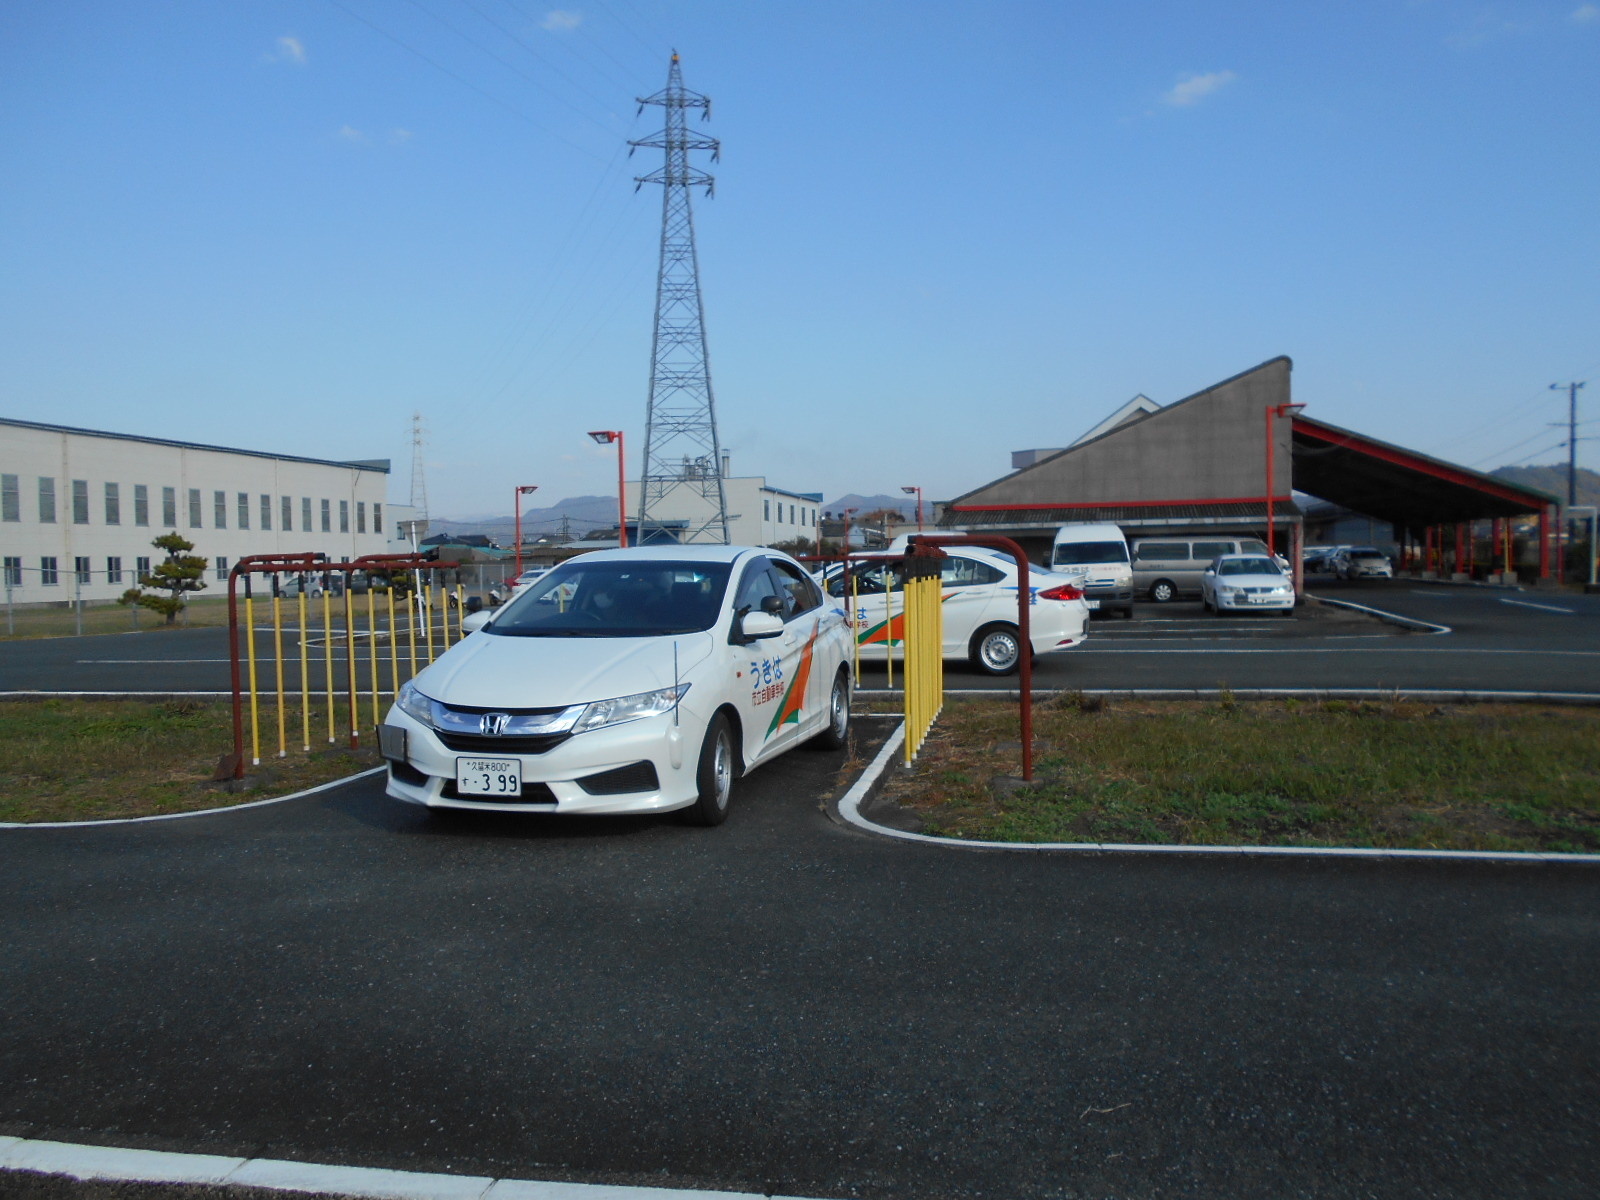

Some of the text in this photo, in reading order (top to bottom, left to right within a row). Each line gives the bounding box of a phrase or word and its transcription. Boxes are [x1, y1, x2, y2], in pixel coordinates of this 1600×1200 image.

[750, 655, 783, 689] うきは
[752, 681, 785, 706] 市立自動車学校
